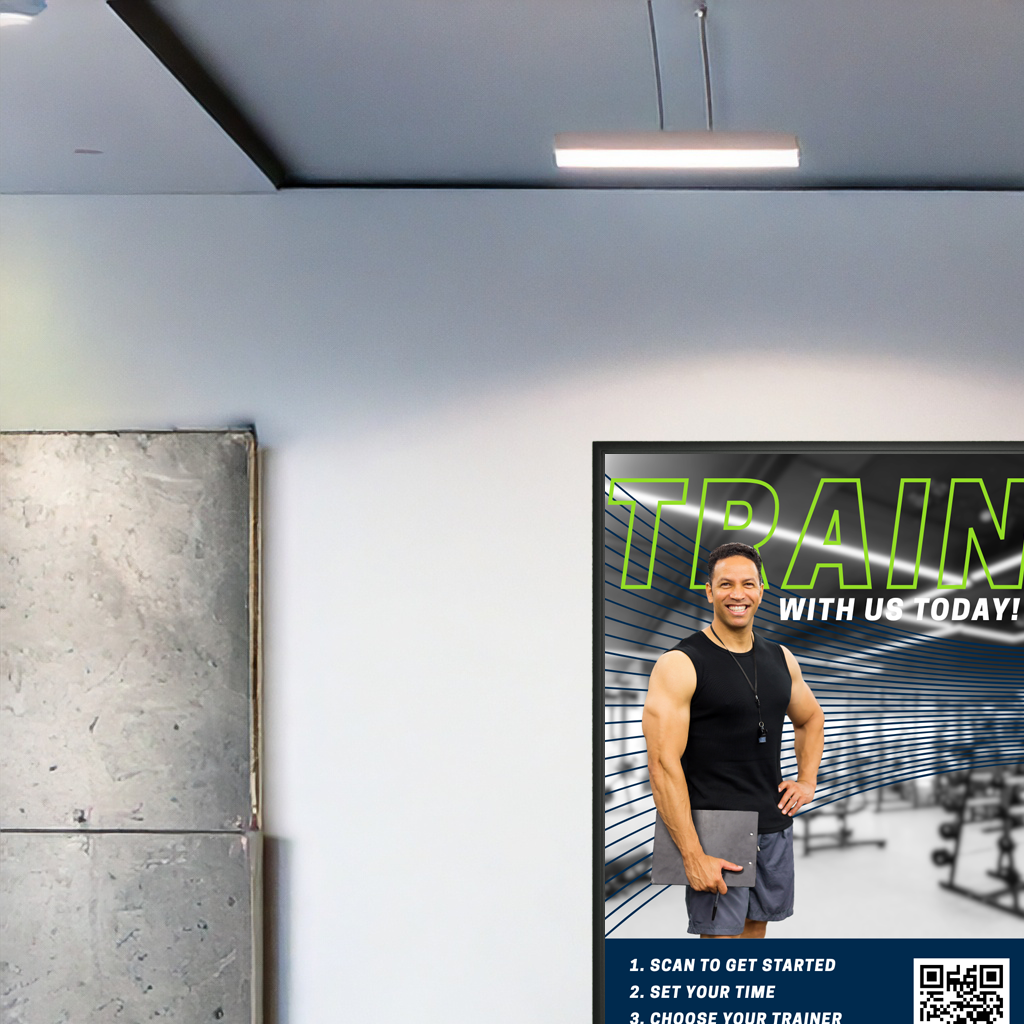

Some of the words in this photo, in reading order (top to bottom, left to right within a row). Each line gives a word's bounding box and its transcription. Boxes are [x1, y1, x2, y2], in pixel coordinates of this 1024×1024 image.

[779, 597, 856, 621] WITH
[864, 597, 904, 621] US
[913, 597, 1021, 621] TODAY!
[629, 958, 645, 972] 1.
[649, 958, 696, 972] SCAN
[700, 958, 721, 972] TO
[725, 958, 758, 972] GET
[761, 958, 836, 972] STARTED
[629, 984, 645, 999] 2.
[649, 984, 682, 999] SET
[686, 984, 731, 999] YOUR
[735, 984, 776, 999] TIME
